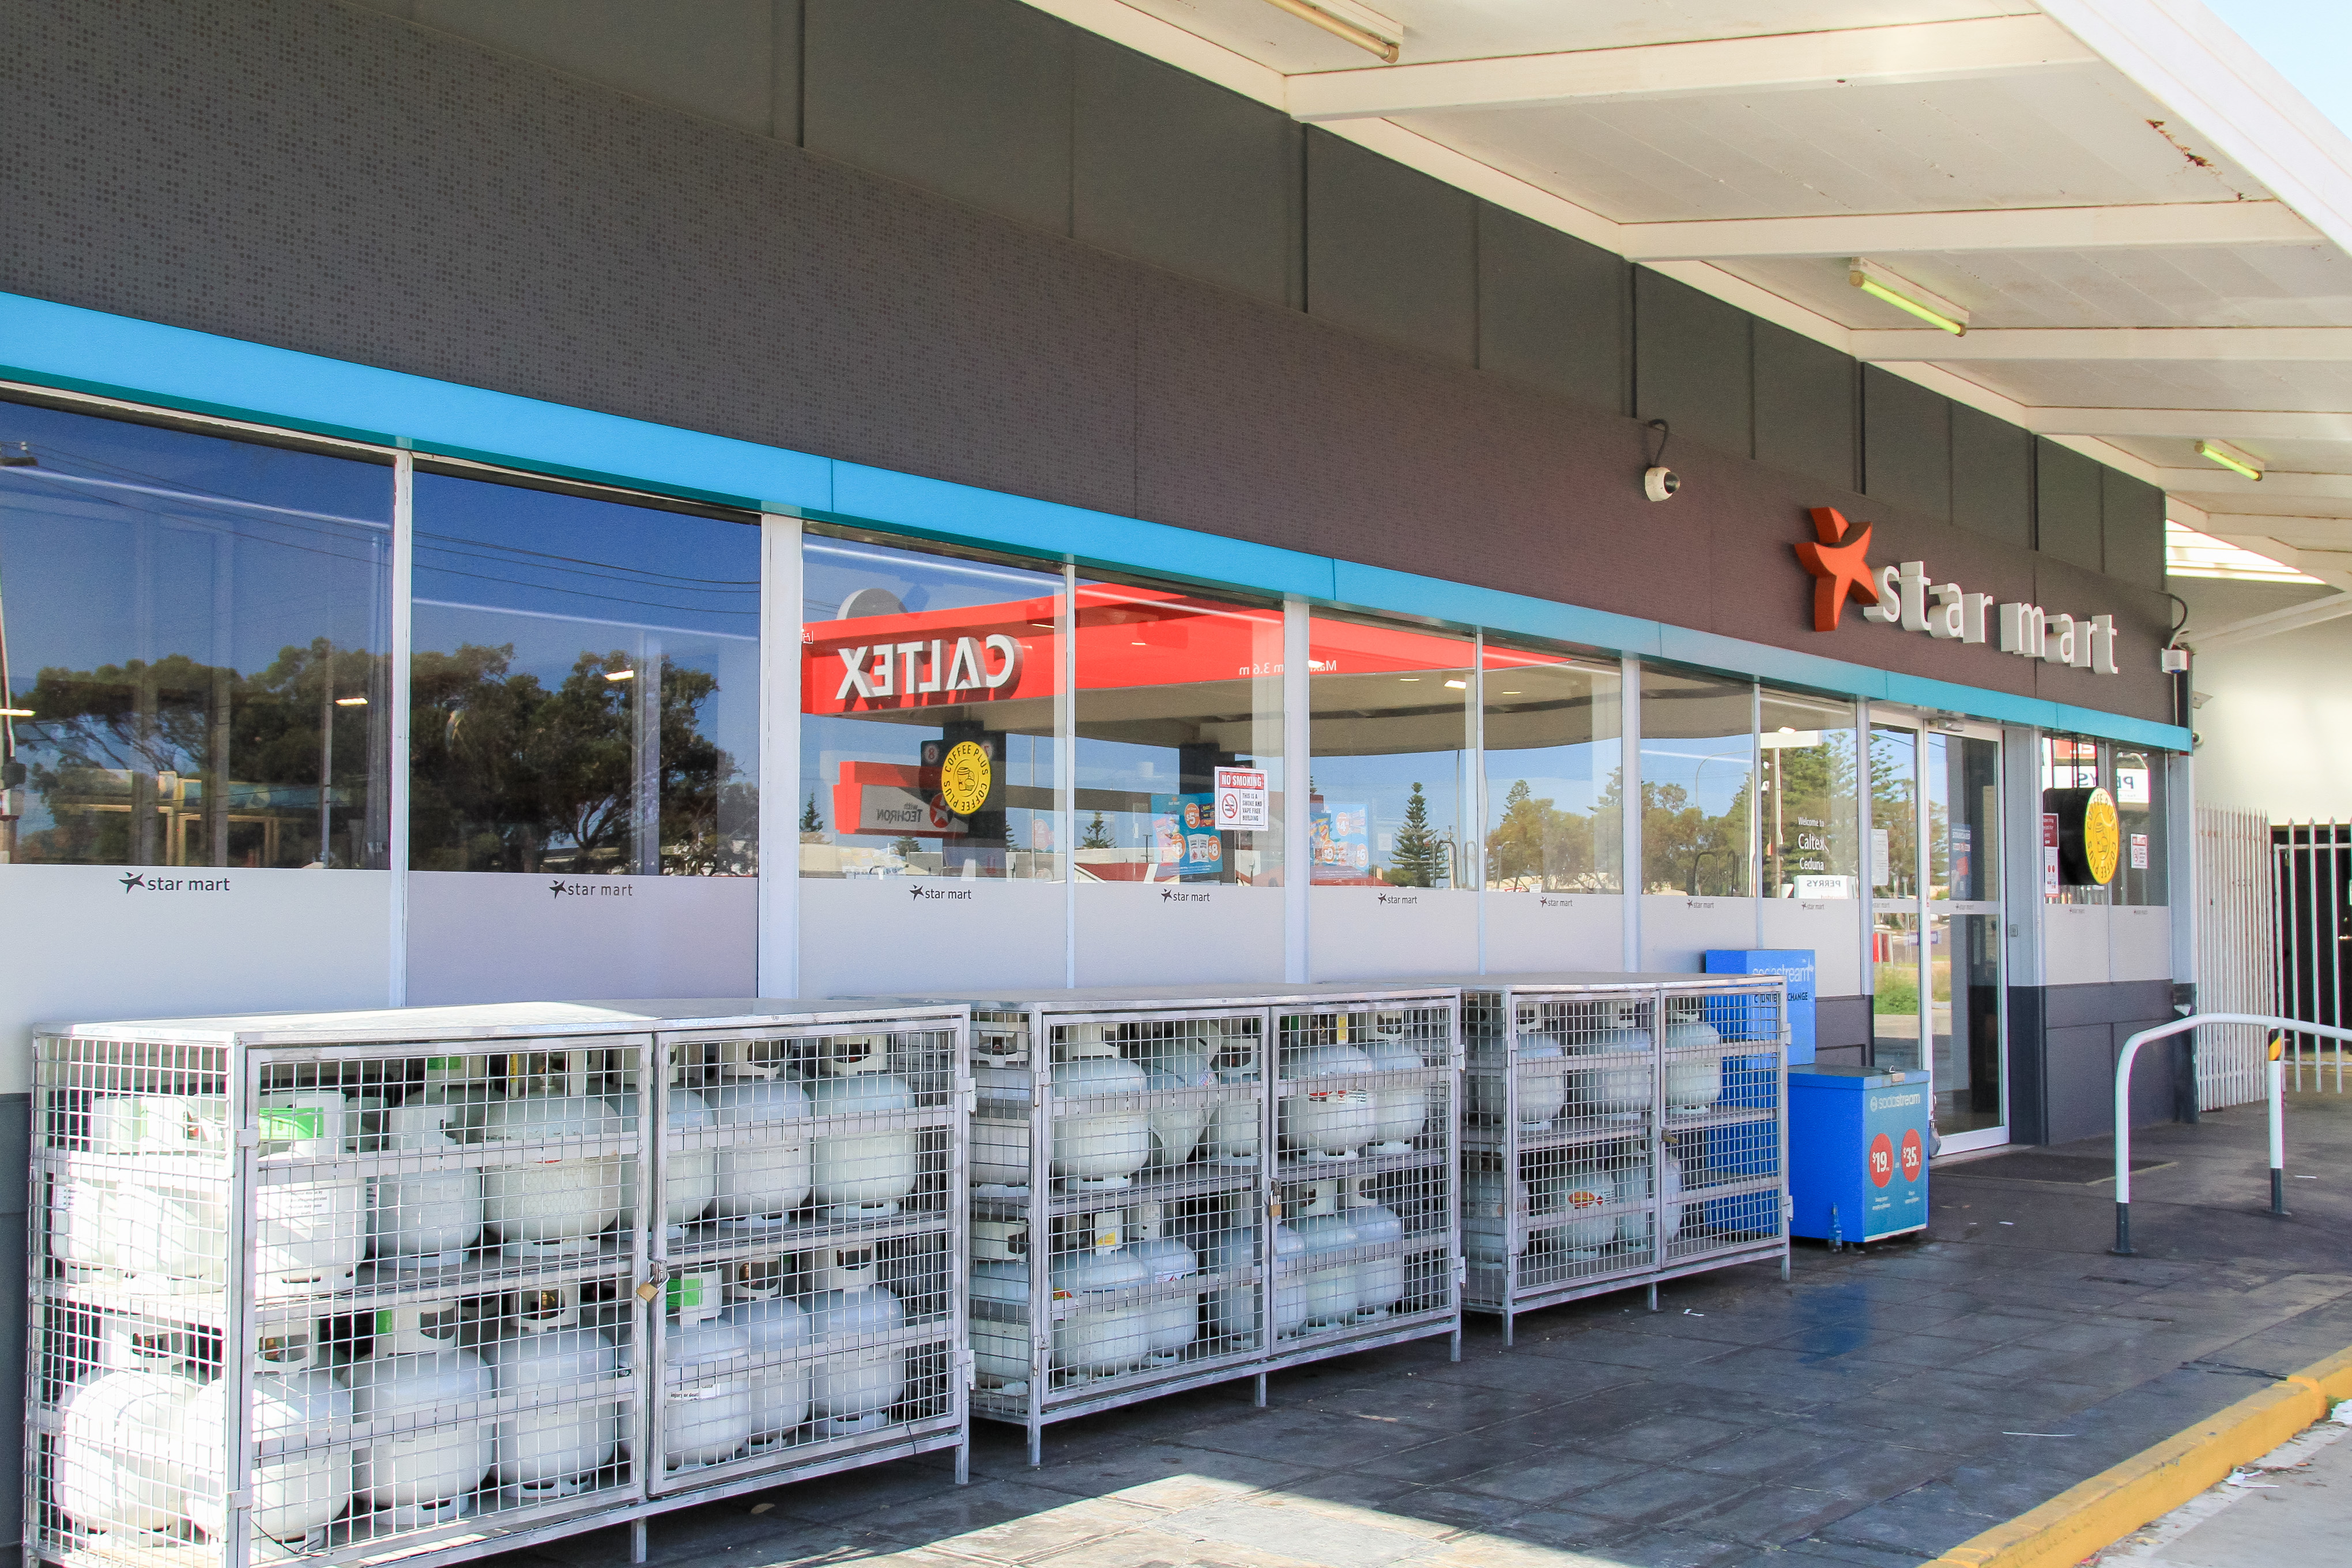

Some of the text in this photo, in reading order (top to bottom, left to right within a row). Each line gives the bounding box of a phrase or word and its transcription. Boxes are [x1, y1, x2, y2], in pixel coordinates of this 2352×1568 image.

[1864, 560, 2119, 675] star mart
[928, 747, 935, 760] 8
[945, 744, 989, 775] COFFEE PLUS
[1222, 774, 1262, 787] NO SMOKING
[944, 781, 988, 811] COFFEE PLUS
[1798, 817, 1825, 827] Welcome to
[1798, 834, 1825, 851] Caltex
[1799, 857, 1825, 871] Ceduna
[148, 877, 231, 891] star mart
[568, 883, 633, 896] star mart
[925, 888, 972, 899] star mart
[1173, 892, 1210, 902] star mart
[1388, 896, 1418, 904] star mart
[1560, 899, 1573, 907] mart
[1787, 992, 1808, 1001] CHANGE
[1878, 1093, 1921, 1109] sodastream
[1872, 1151, 1888, 1173] $19
[1903, 1146, 1917, 1167] $35
